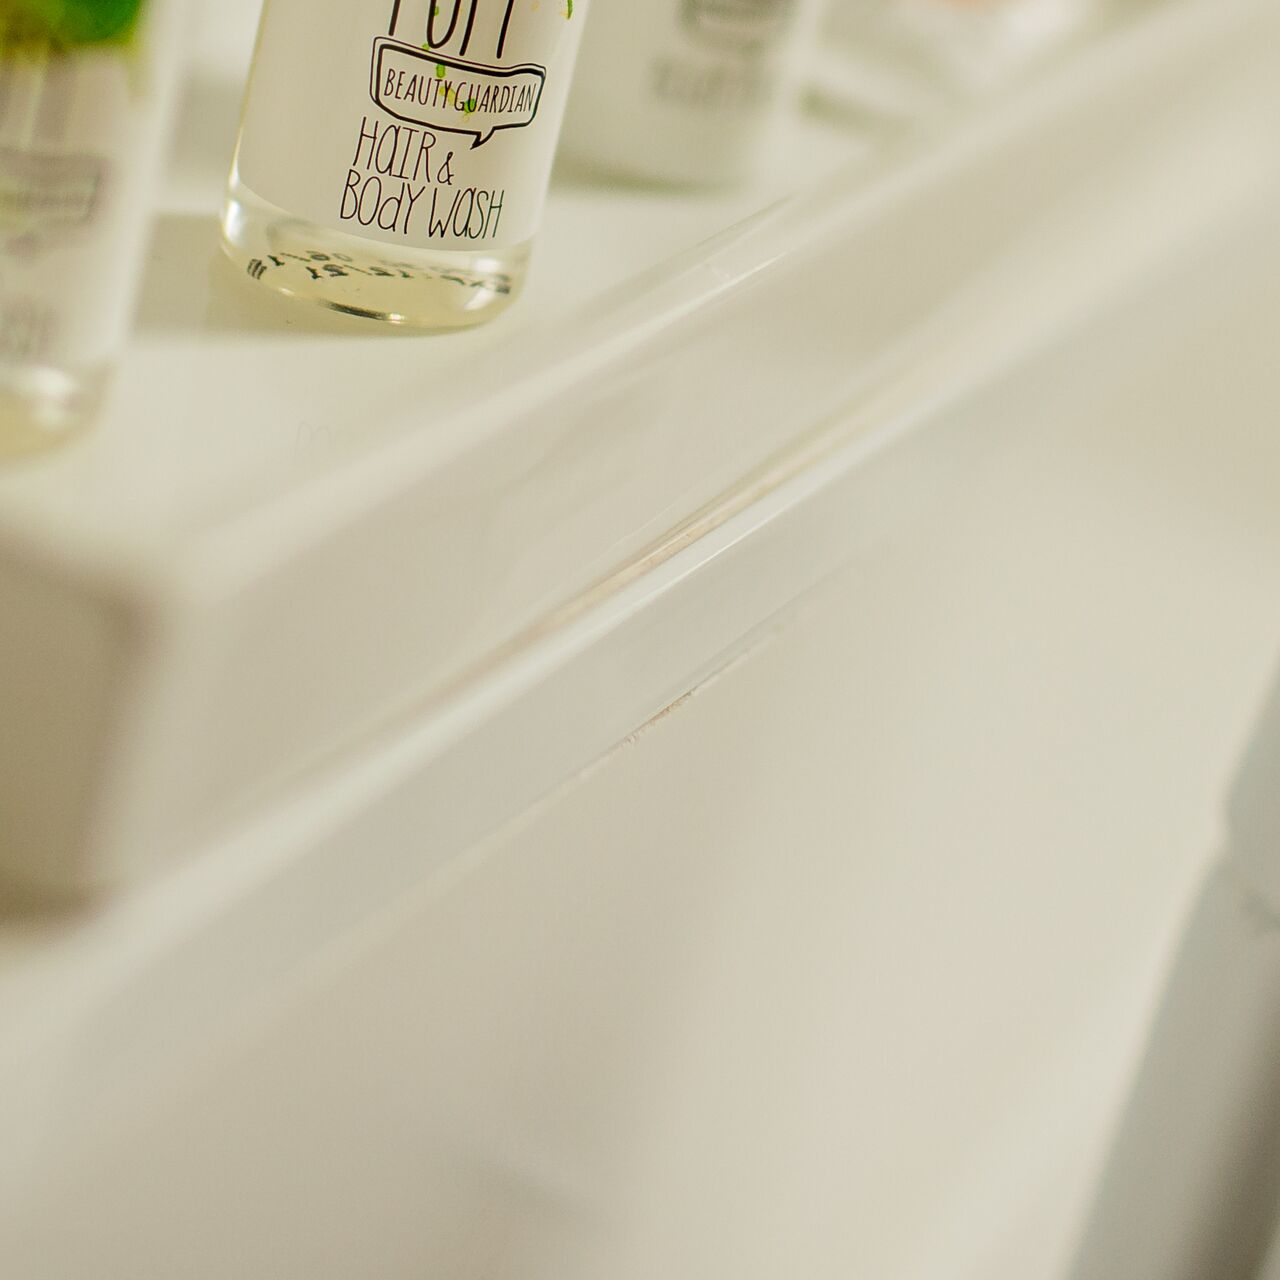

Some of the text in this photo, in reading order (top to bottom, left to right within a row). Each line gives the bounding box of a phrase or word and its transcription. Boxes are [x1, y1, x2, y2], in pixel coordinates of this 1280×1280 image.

[384, 68, 536, 113] BEAUTY GUARDIAN
[437, 151, 454, 185] &
